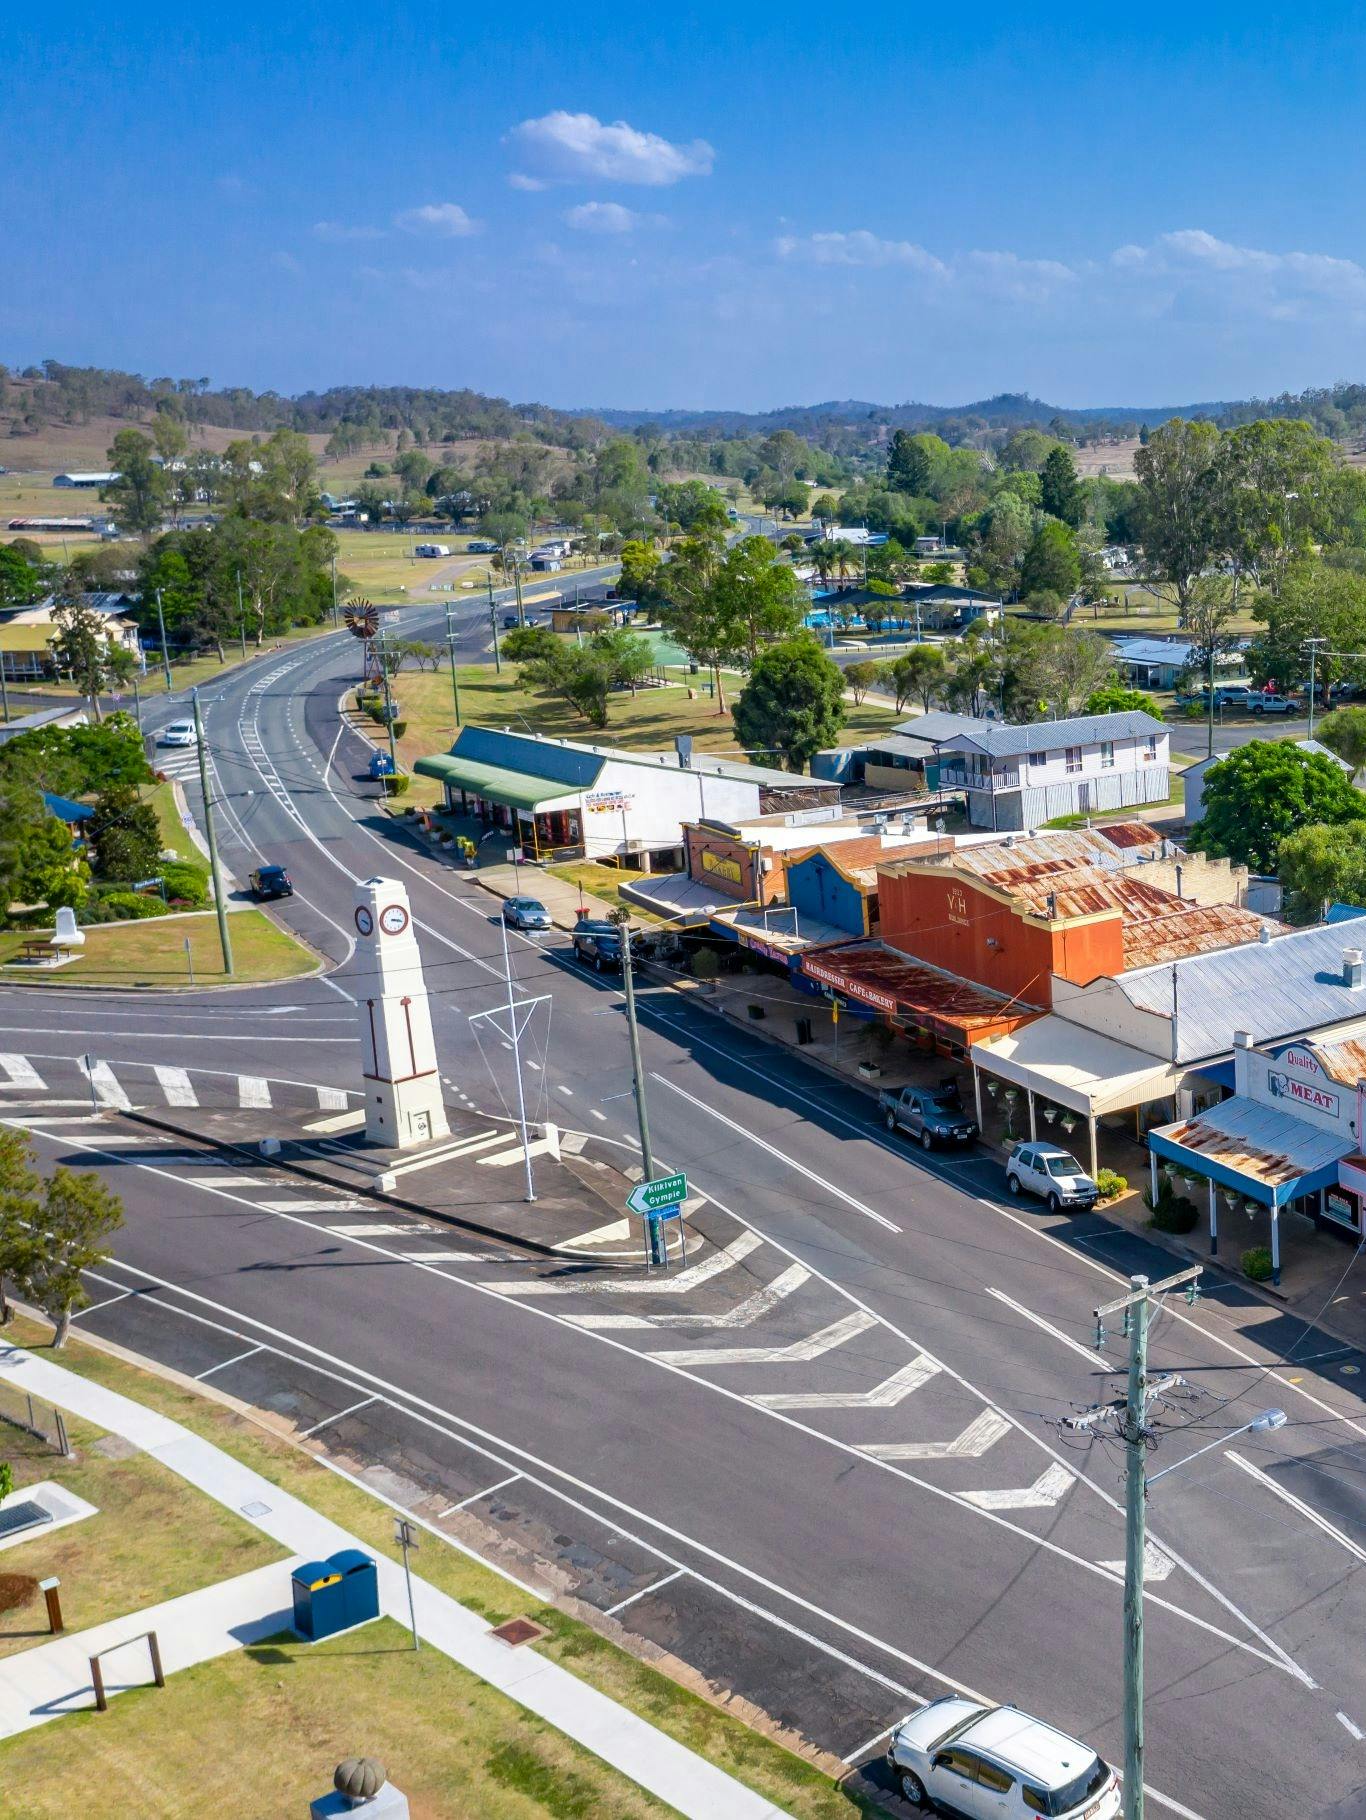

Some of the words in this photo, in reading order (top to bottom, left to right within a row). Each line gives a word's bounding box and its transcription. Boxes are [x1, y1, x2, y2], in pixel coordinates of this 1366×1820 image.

[805, 961, 846, 988] HAIRDRESSER
[849, 982, 866, 997] CAFE
[1287, 1050, 1319, 1074] Quality
[1290, 1081, 1334, 1109] MEAT
[648, 1179, 682, 1194] Kilkivan
[649, 1190, 680, 1204] Gympie
